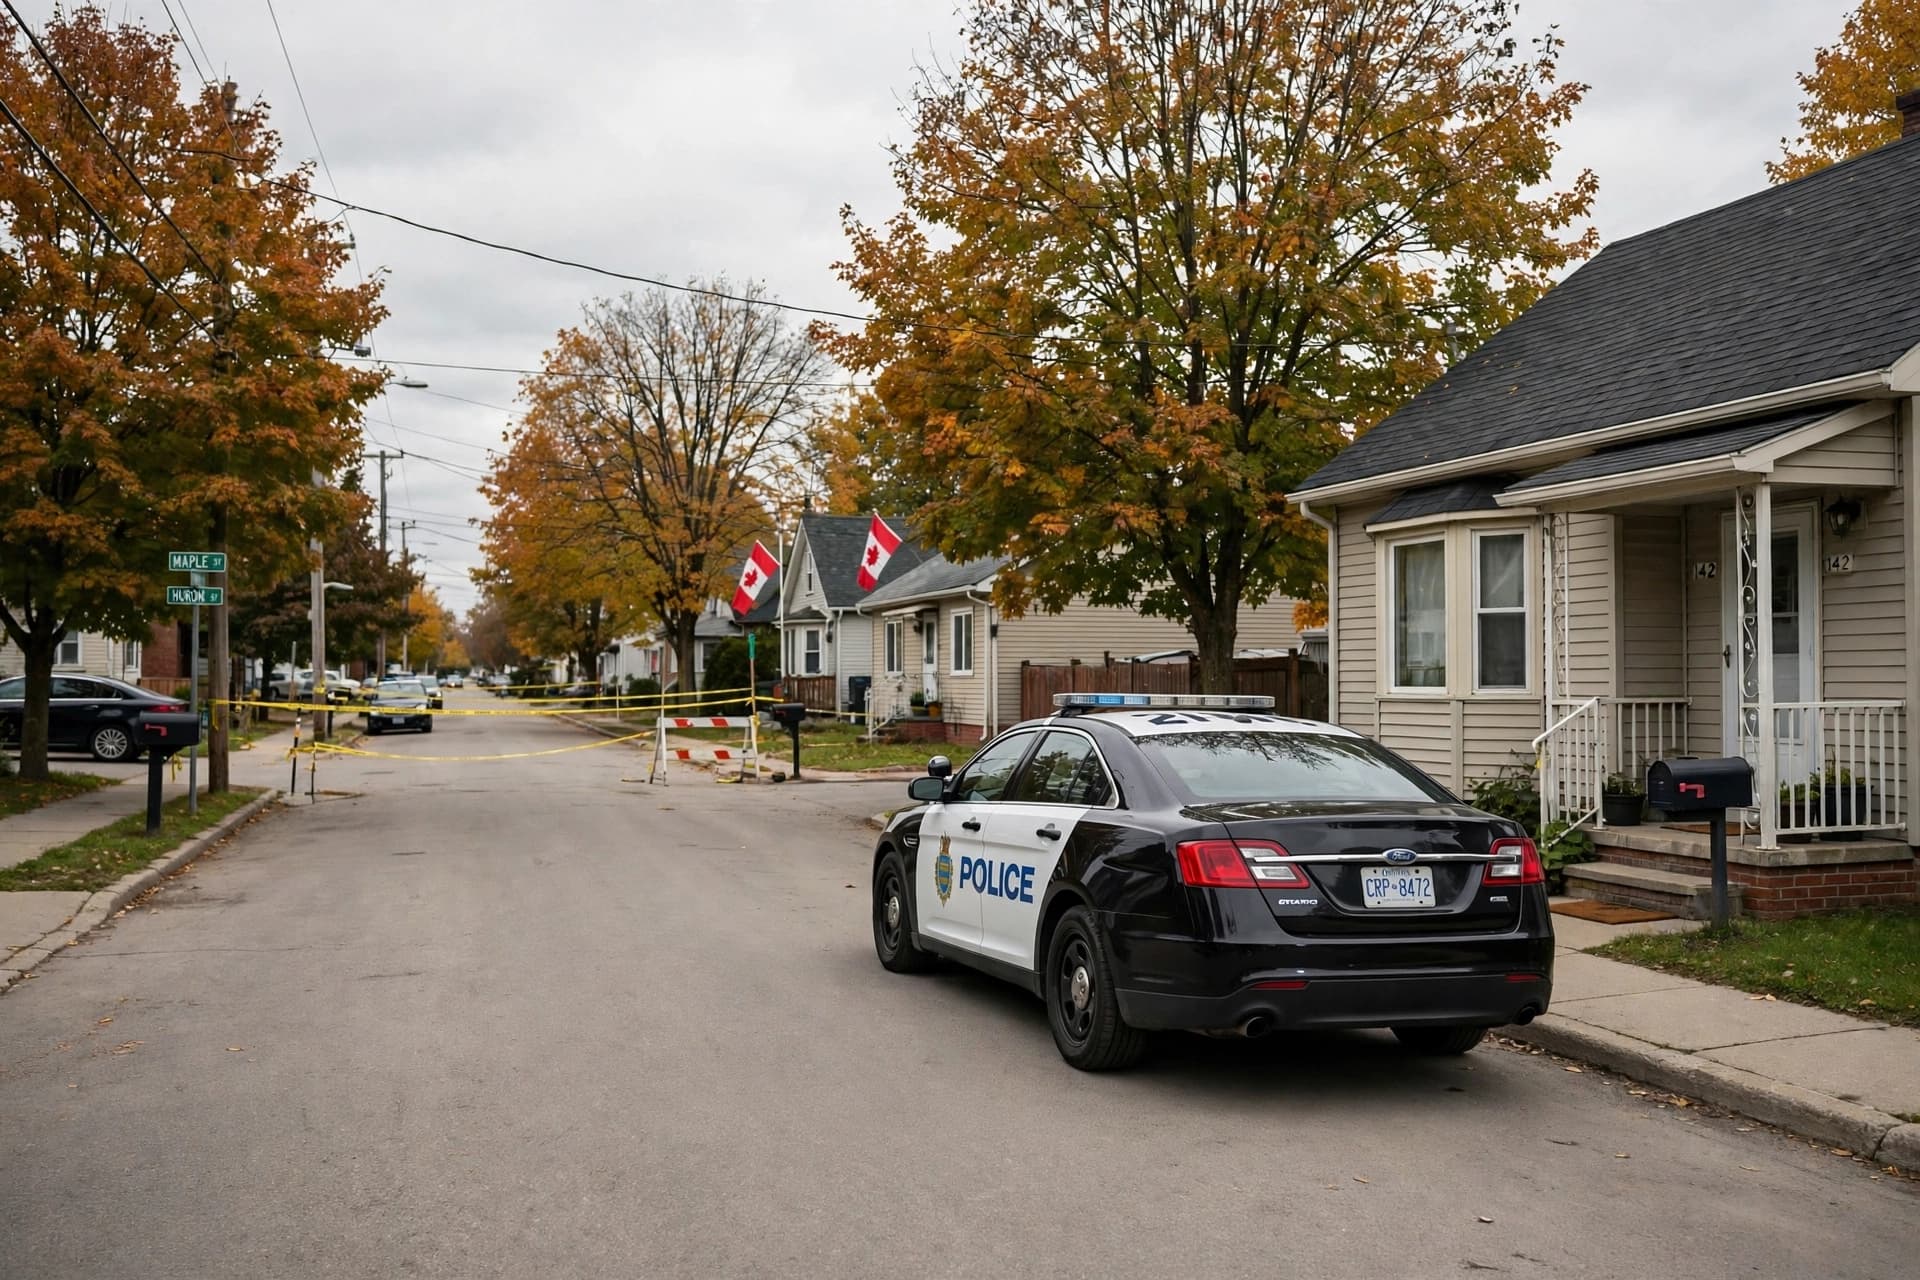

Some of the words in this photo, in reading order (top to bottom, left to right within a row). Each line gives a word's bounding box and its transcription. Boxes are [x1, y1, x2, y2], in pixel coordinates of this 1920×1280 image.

[173, 555, 209, 569] MAPLE
[1828, 554, 1849, 571] 142
[959, 856, 1036, 904] POLICE
